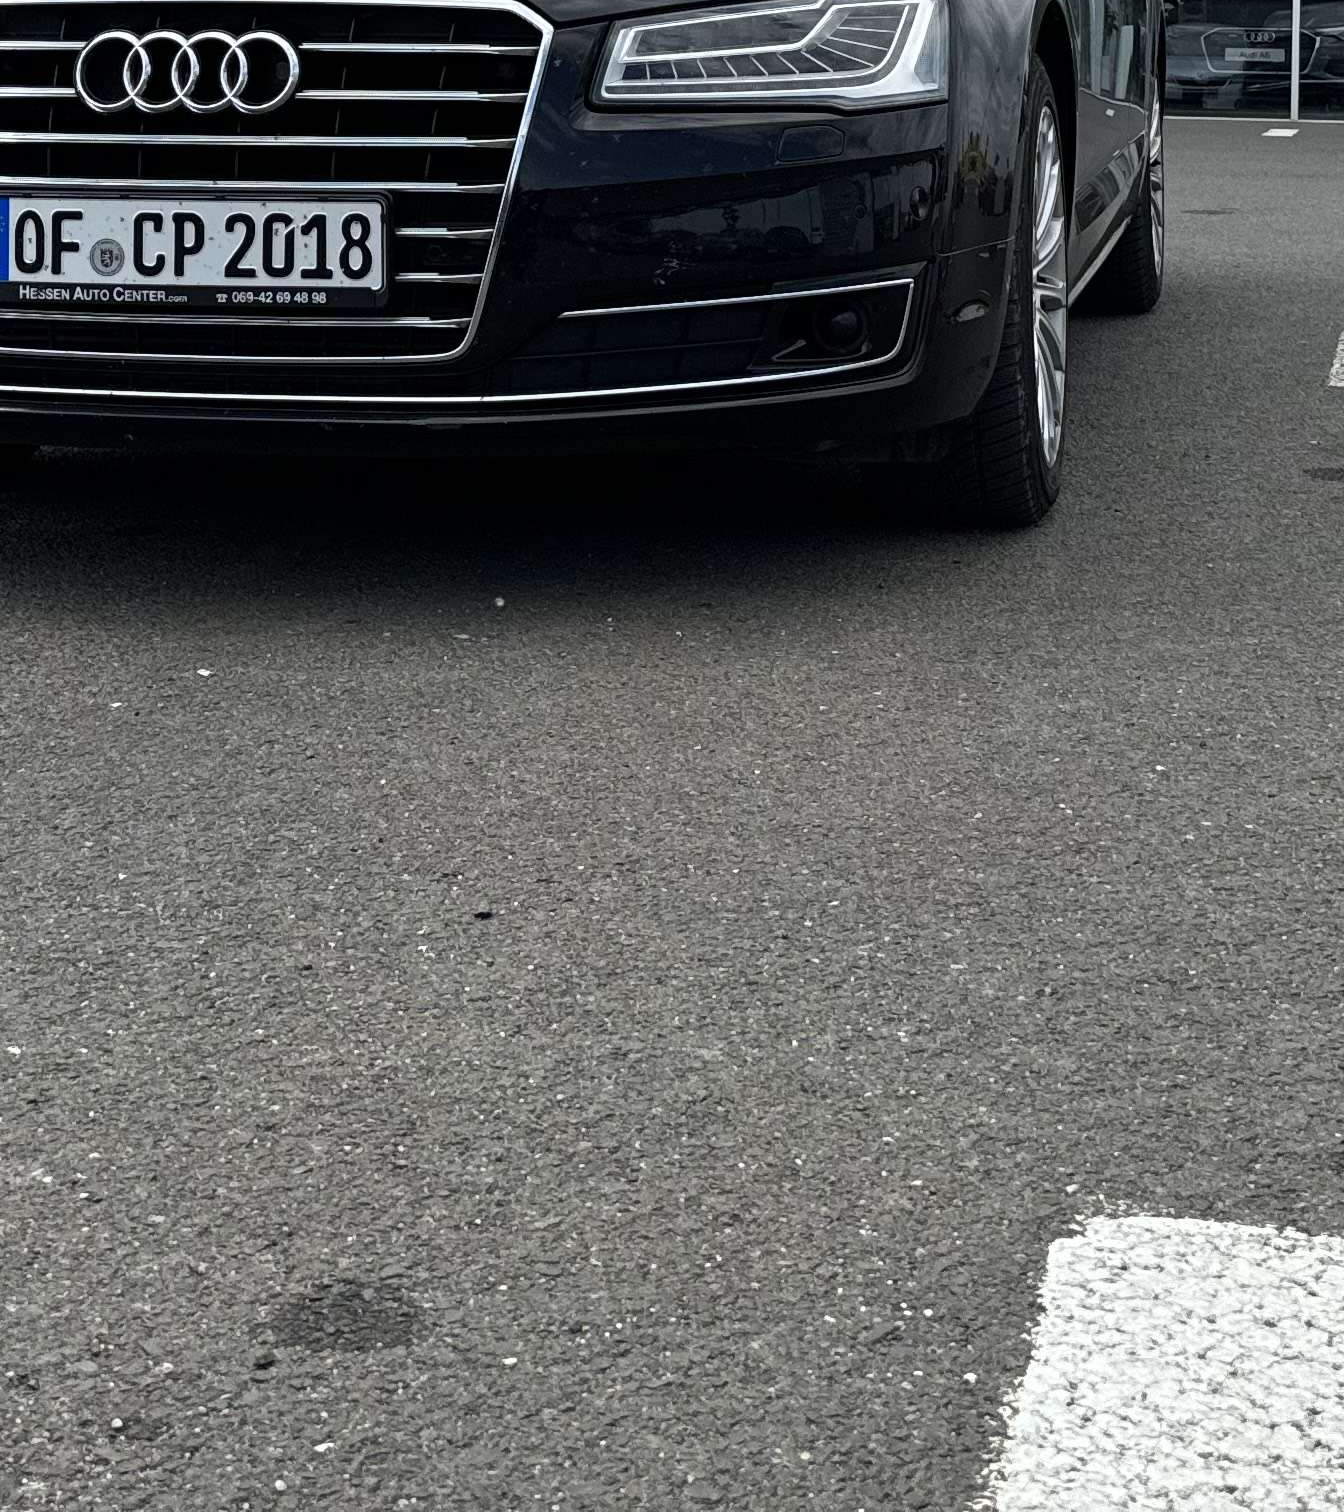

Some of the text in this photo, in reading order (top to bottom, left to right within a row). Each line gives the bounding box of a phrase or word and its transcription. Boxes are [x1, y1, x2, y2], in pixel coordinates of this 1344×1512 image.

[14, 208, 373, 280] OF CP 2018
[19, 285, 70, 300] HESSEN
[73, 286, 110, 302] AUTO
[231, 291, 327, 304] 069-42 69 48 98
